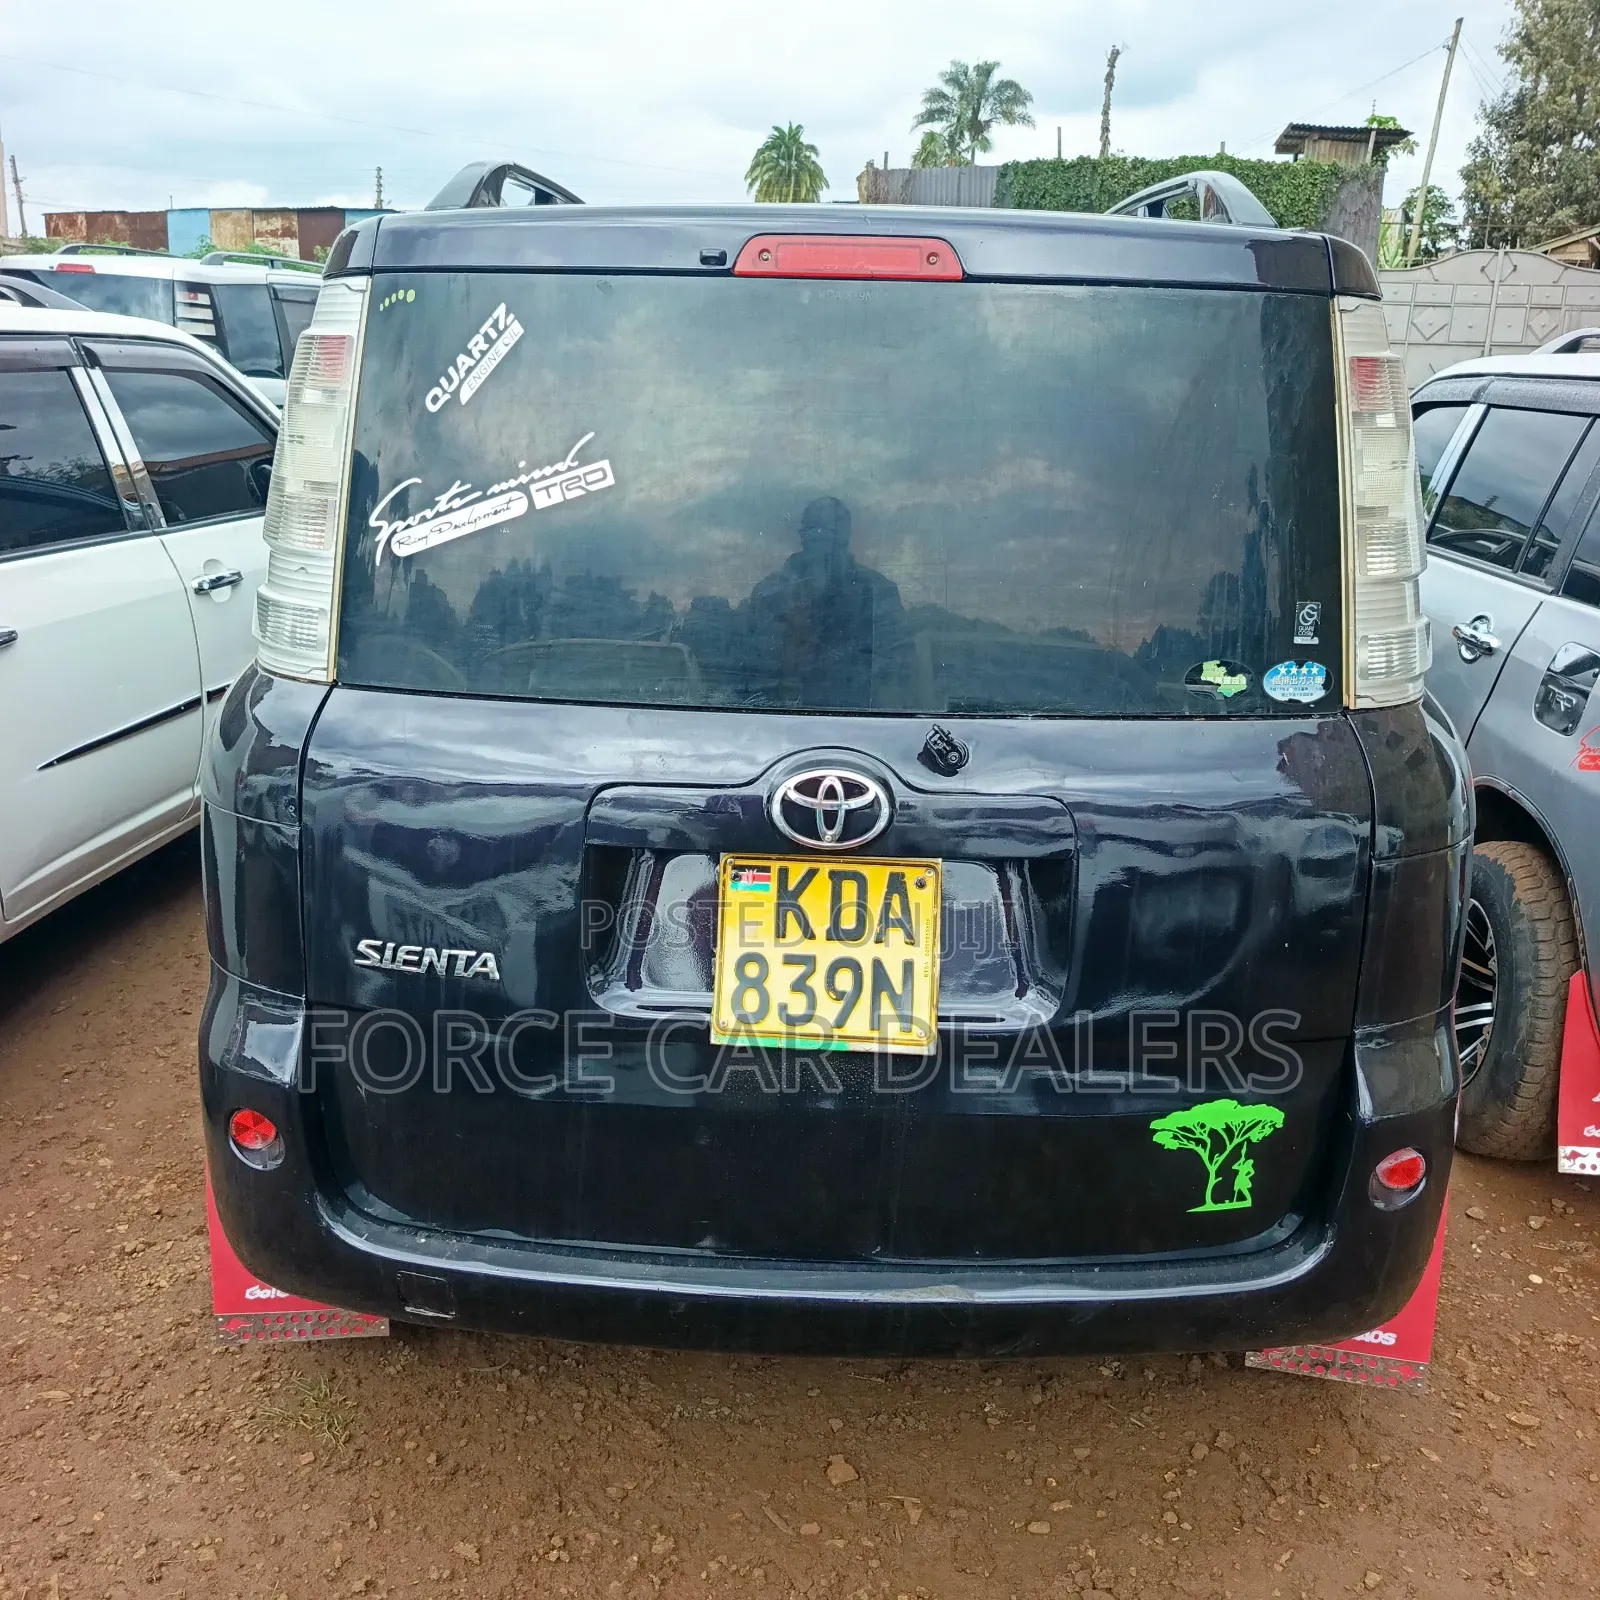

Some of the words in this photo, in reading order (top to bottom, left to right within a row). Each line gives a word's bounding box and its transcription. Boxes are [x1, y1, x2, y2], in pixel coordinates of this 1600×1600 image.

[425, 302, 515, 413] QUARTZ
[466, 345, 503, 391] ENGINE
[502, 328, 520, 347] OIL
[535, 467, 608, 501] TRD
[776, 866, 915, 945] KDA
[354, 939, 500, 981] SIENTA
[731, 952, 914, 1033] 839N
